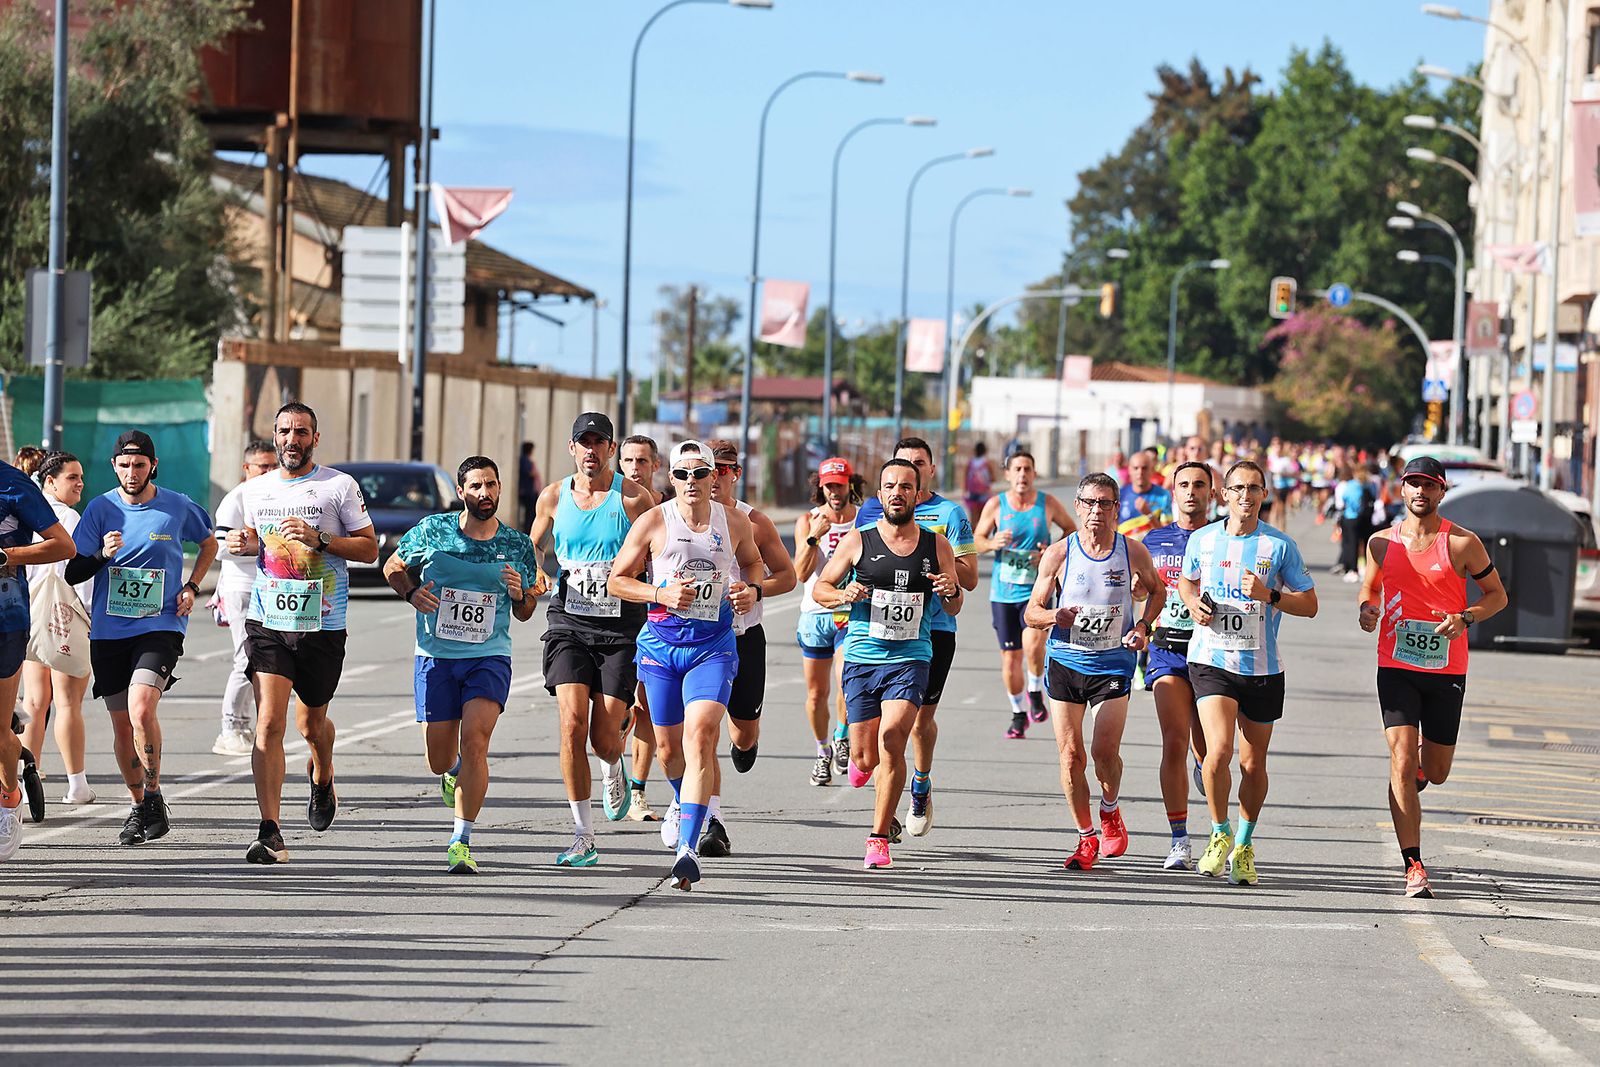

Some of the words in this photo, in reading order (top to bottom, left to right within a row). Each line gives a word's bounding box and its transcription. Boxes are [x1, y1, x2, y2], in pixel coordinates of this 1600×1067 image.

[1009, 558, 1030, 571] 462
[150, 571, 161, 580] 2K
[673, 571, 685, 580] 2K
[117, 581, 154, 598] 437
[307, 581, 319, 591] 2K
[577, 580, 608, 598] 141
[276, 594, 311, 612] 667
[445, 590, 456, 600] 2K
[482, 595, 493, 604] 2K
[911, 594, 920, 603] 2K
[451, 603, 485, 624] 168
[881, 605, 914, 622] 130
[1110, 606, 1120, 614] 2K
[1245, 603, 1256, 611] 2K
[441, 623, 465, 631] RAMIREZ
[1080, 618, 1114, 633] 247
[1220, 615, 1243, 631] 10
[1399, 621, 1410, 630] 2K
[438, 627, 463, 637] Huelva
[1405, 633, 1440, 651] 585
